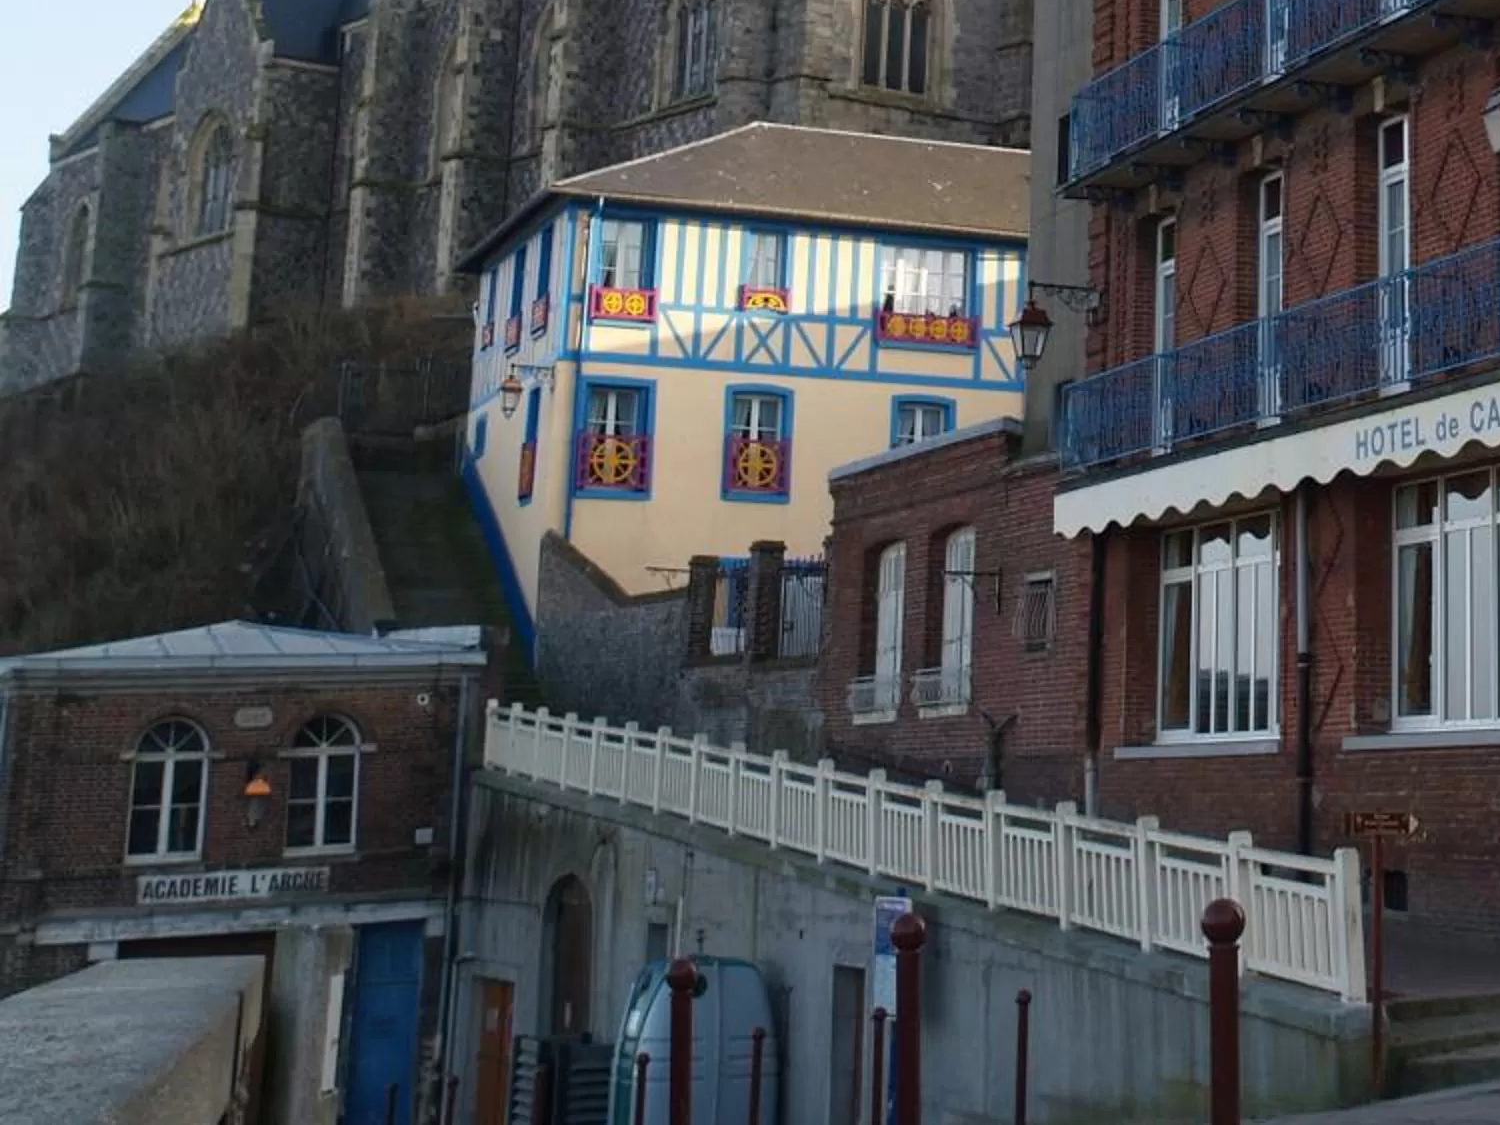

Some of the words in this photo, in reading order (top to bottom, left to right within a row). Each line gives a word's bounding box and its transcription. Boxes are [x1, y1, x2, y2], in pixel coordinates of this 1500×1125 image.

[1355, 417, 1425, 460] HOTEL
[1436, 412, 1459, 442] de
[142, 875, 239, 900] ACADEMIE
